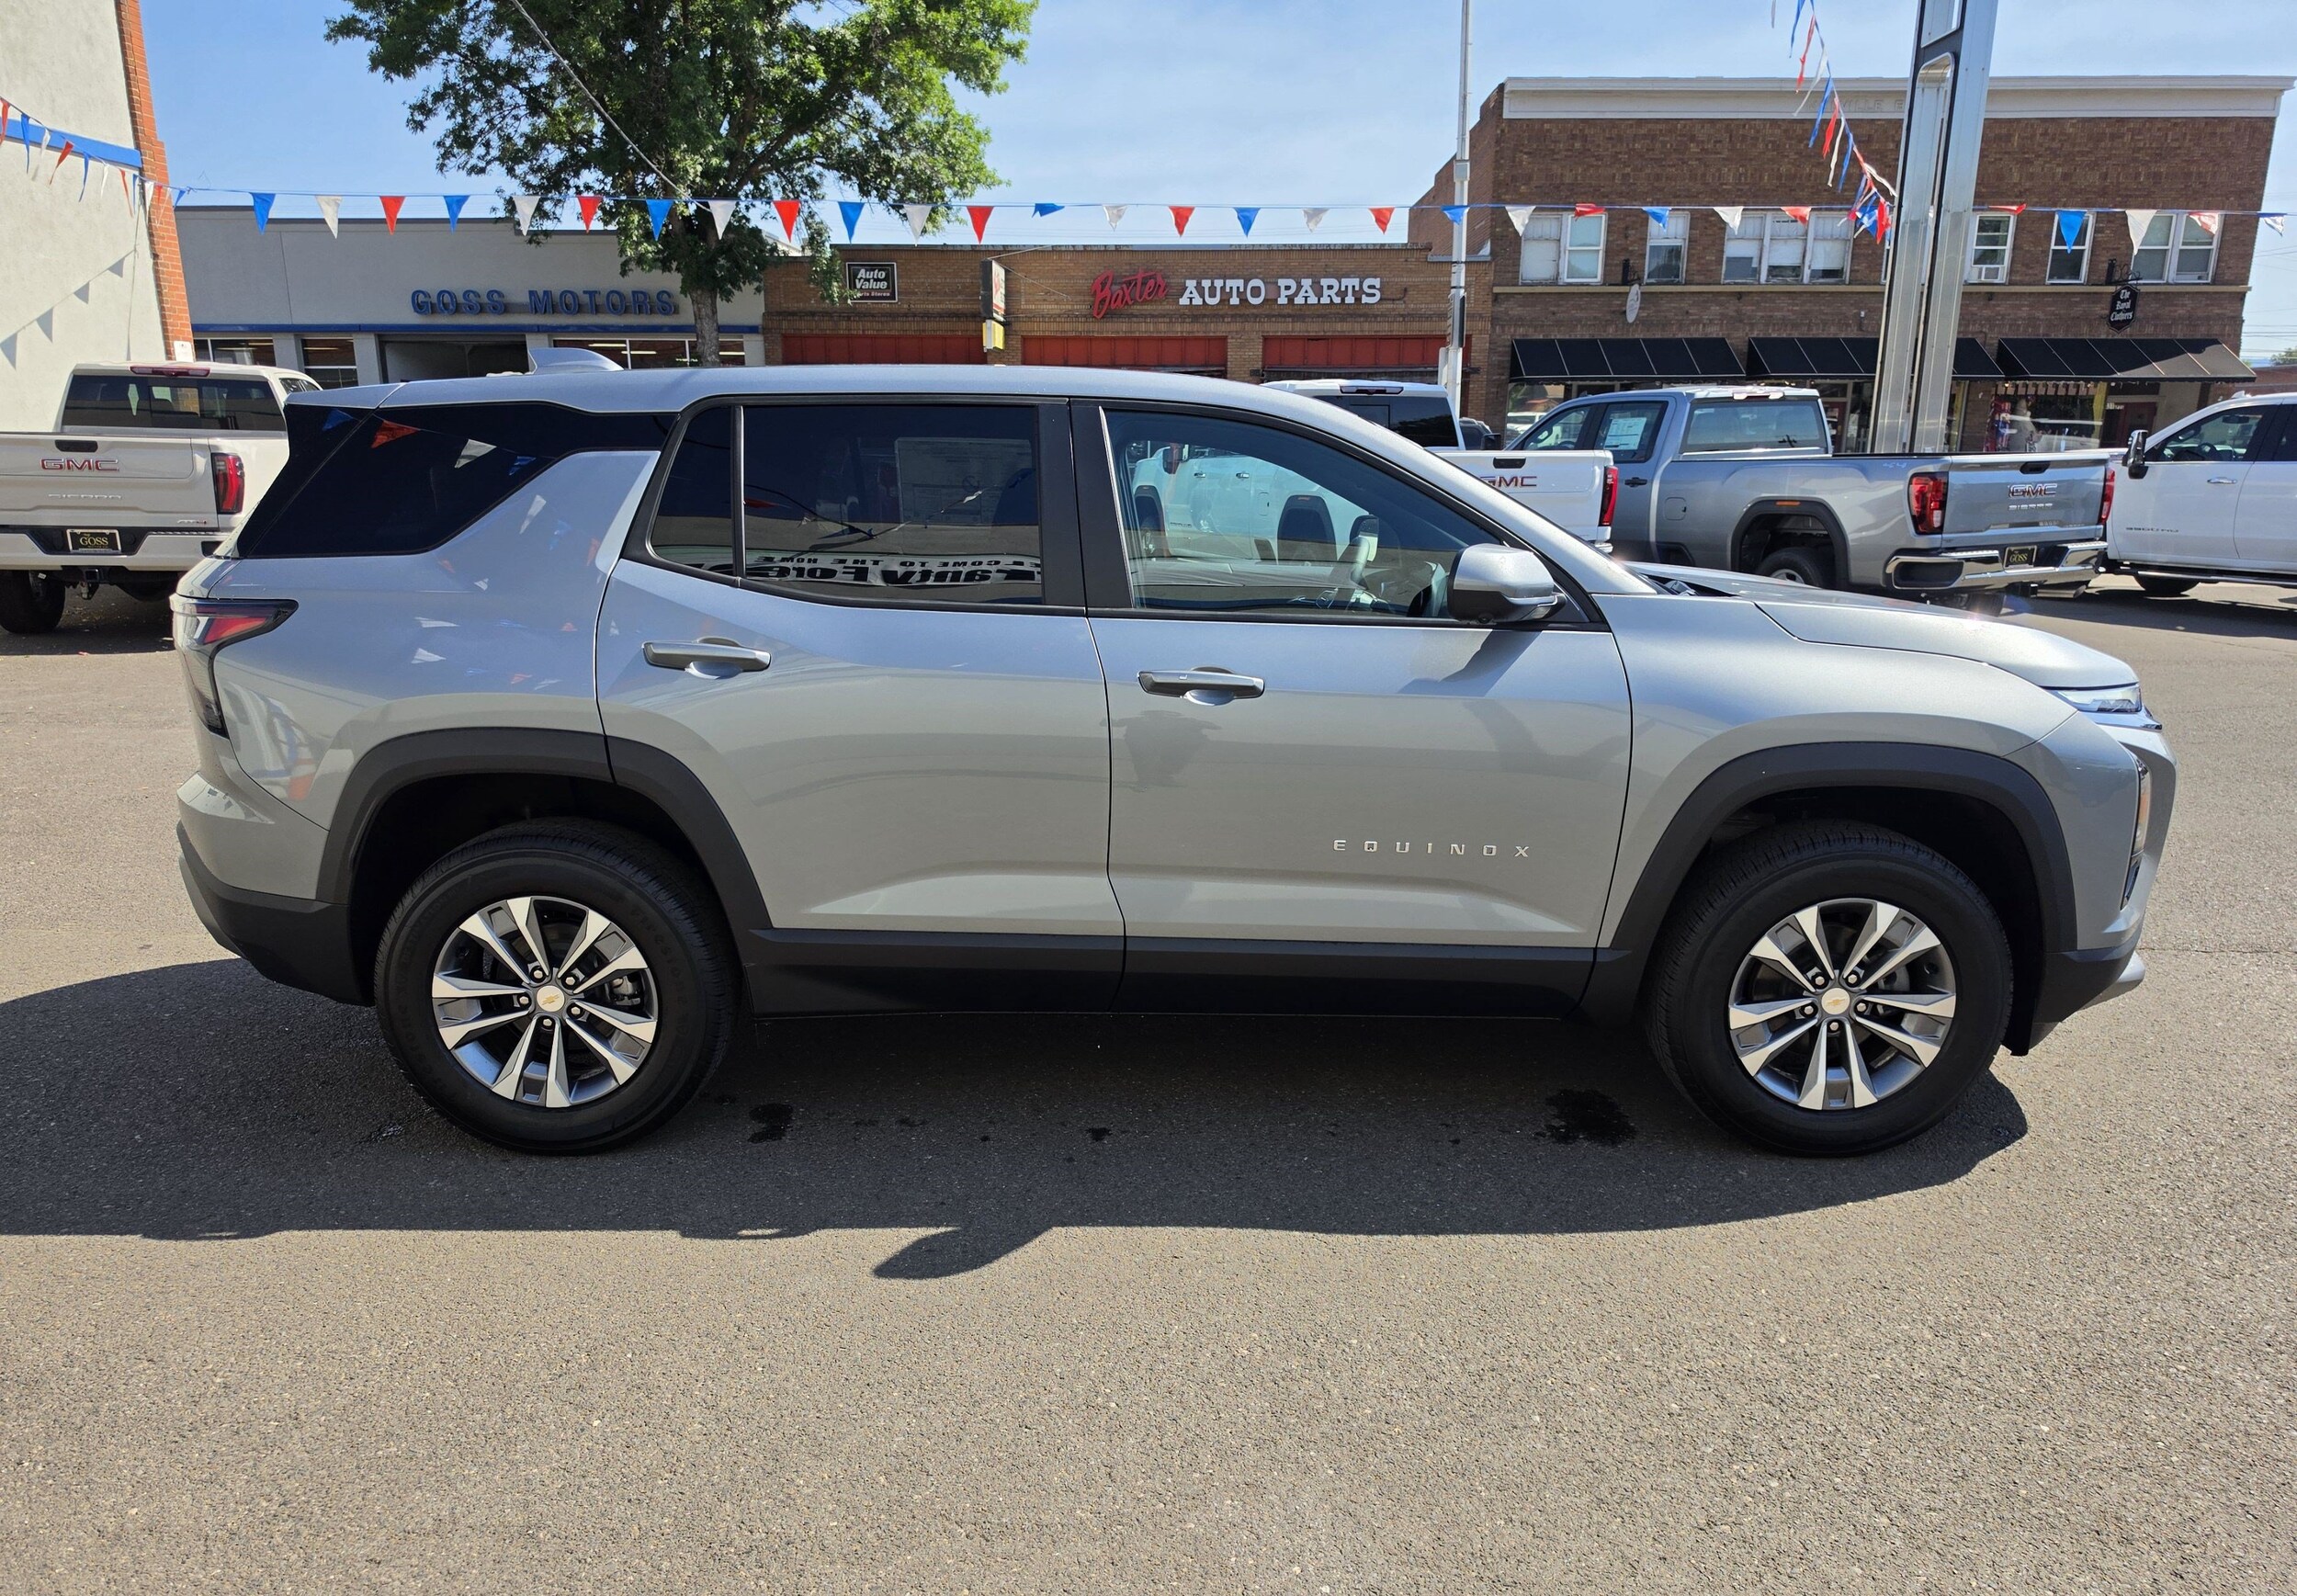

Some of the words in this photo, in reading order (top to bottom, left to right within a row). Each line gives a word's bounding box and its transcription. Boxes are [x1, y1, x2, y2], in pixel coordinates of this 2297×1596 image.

[856, 268, 886, 279] Auto
[854, 278, 888, 289] Value
[1091, 270, 1169, 319] Baxter
[1179, 278, 1266, 305] AUTO
[1277, 277, 1381, 305] PARTS
[411, 289, 505, 315] GOSS
[528, 289, 676, 315] MOTORS
[40, 458, 119, 471] GMC
[2008, 482, 2058, 498] GMC
[79, 537, 109, 545] GOSS
[1333, 839, 1529, 858] EQUINOX
